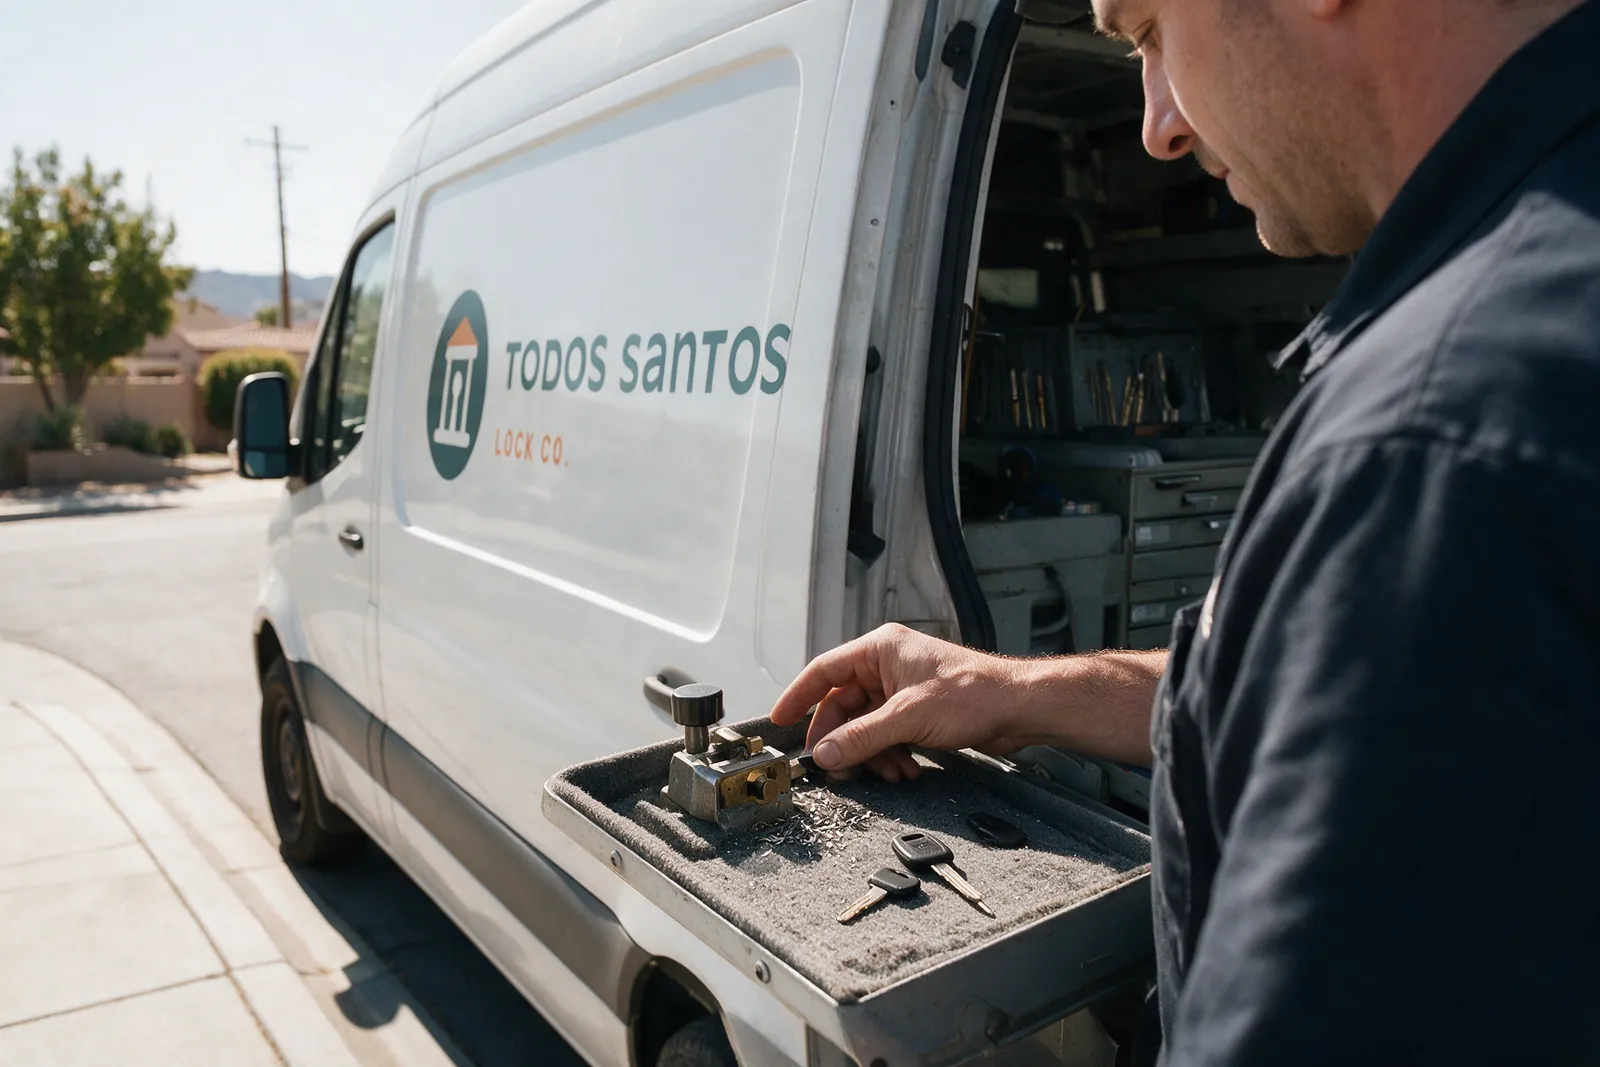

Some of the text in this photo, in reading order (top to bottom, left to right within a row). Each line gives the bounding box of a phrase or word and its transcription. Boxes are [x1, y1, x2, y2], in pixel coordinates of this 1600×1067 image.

[505, 334, 608, 392] TODOS
[494, 428, 569, 468] LOCK CO.
